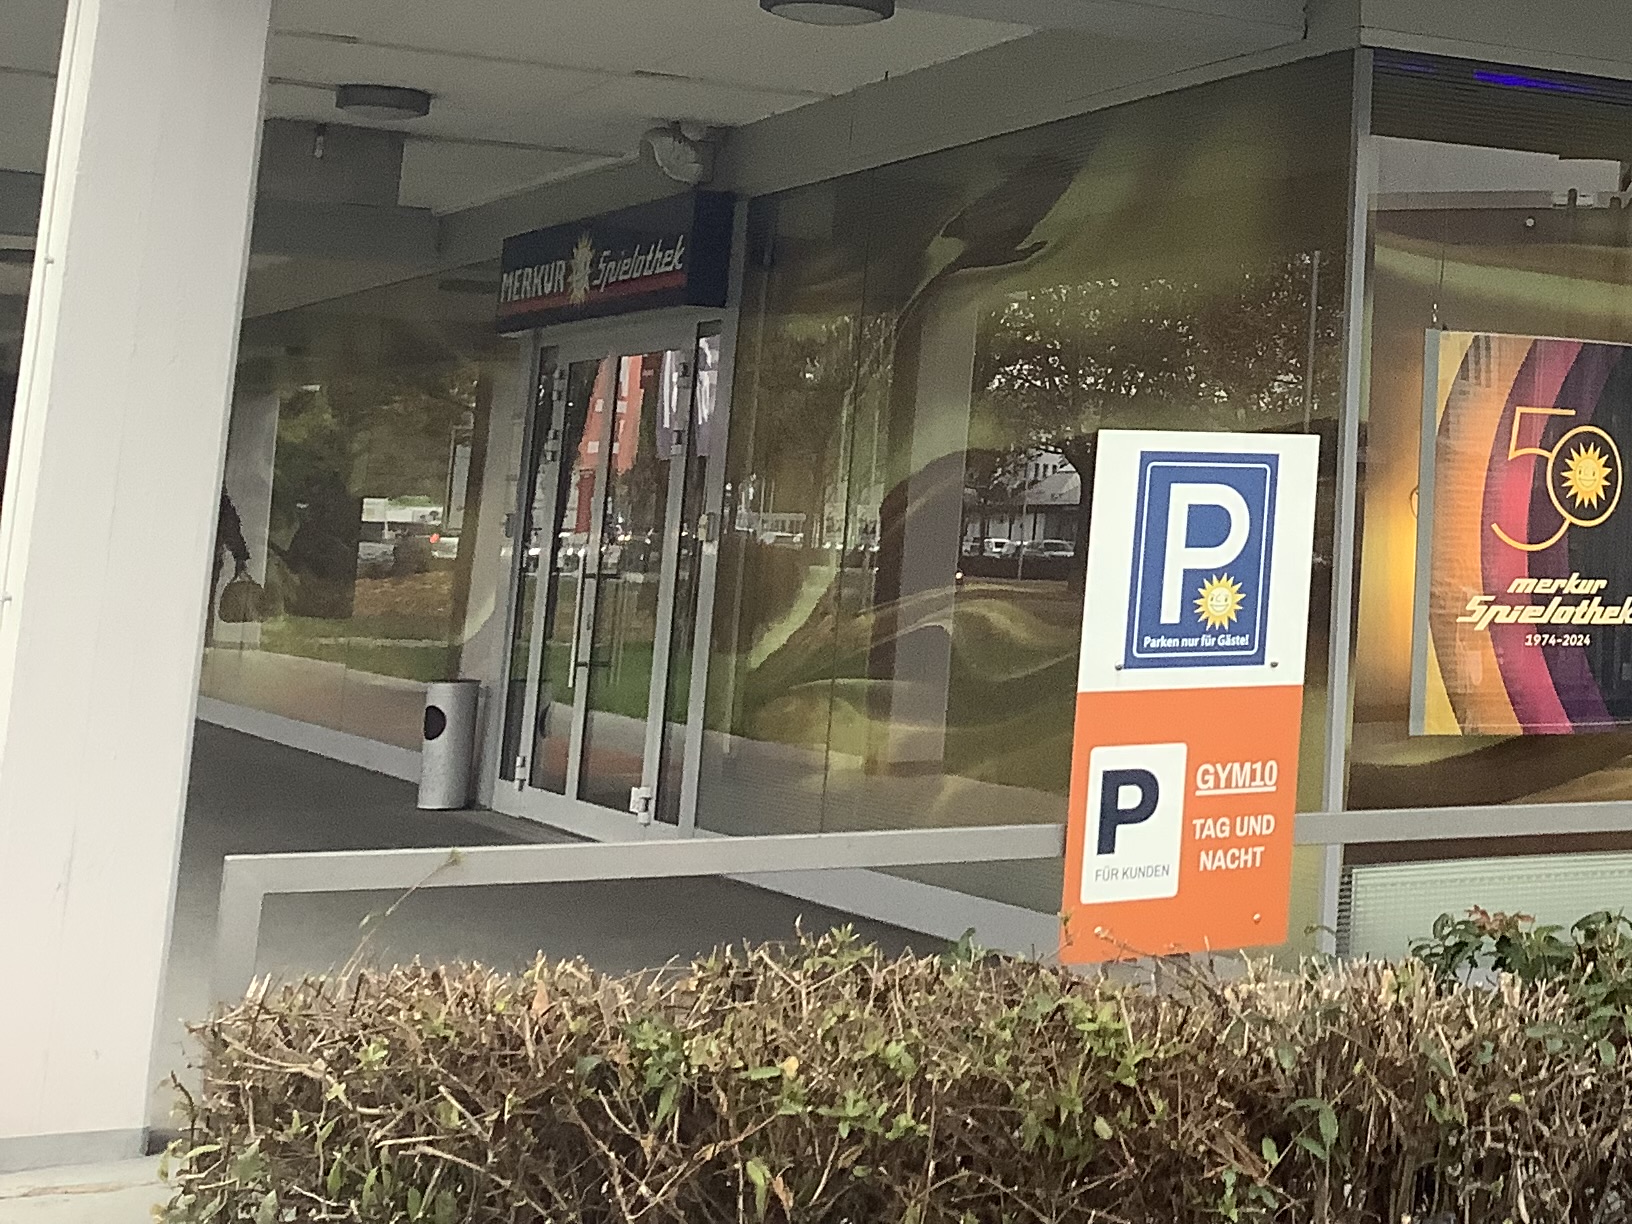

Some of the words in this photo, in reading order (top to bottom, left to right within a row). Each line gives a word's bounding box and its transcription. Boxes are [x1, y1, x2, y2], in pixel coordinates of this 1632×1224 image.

[500, 260, 566, 303] MERKUR
[592, 234, 685, 292] Spielothek
[1160, 482, 1251, 624] P
[1506, 572, 1608, 594] merkur
[1143, 635, 1180, 648] Parken
[1181, 637, 1200, 647] nur
[1200, 634, 1217, 647] für
[1217, 634, 1250, 647] Gäste!
[1524, 634, 1591, 646] 1974-2024
[1196, 760, 1278, 792] GYM10
[1096, 768, 1160, 856] P
[1192, 817, 1231, 840] TAG
[1235, 814, 1275, 836] UND
[1199, 846, 1265, 871] NACHT
[1095, 866, 1119, 882] FÜR
[1122, 864, 1170, 879] KUNDEN
